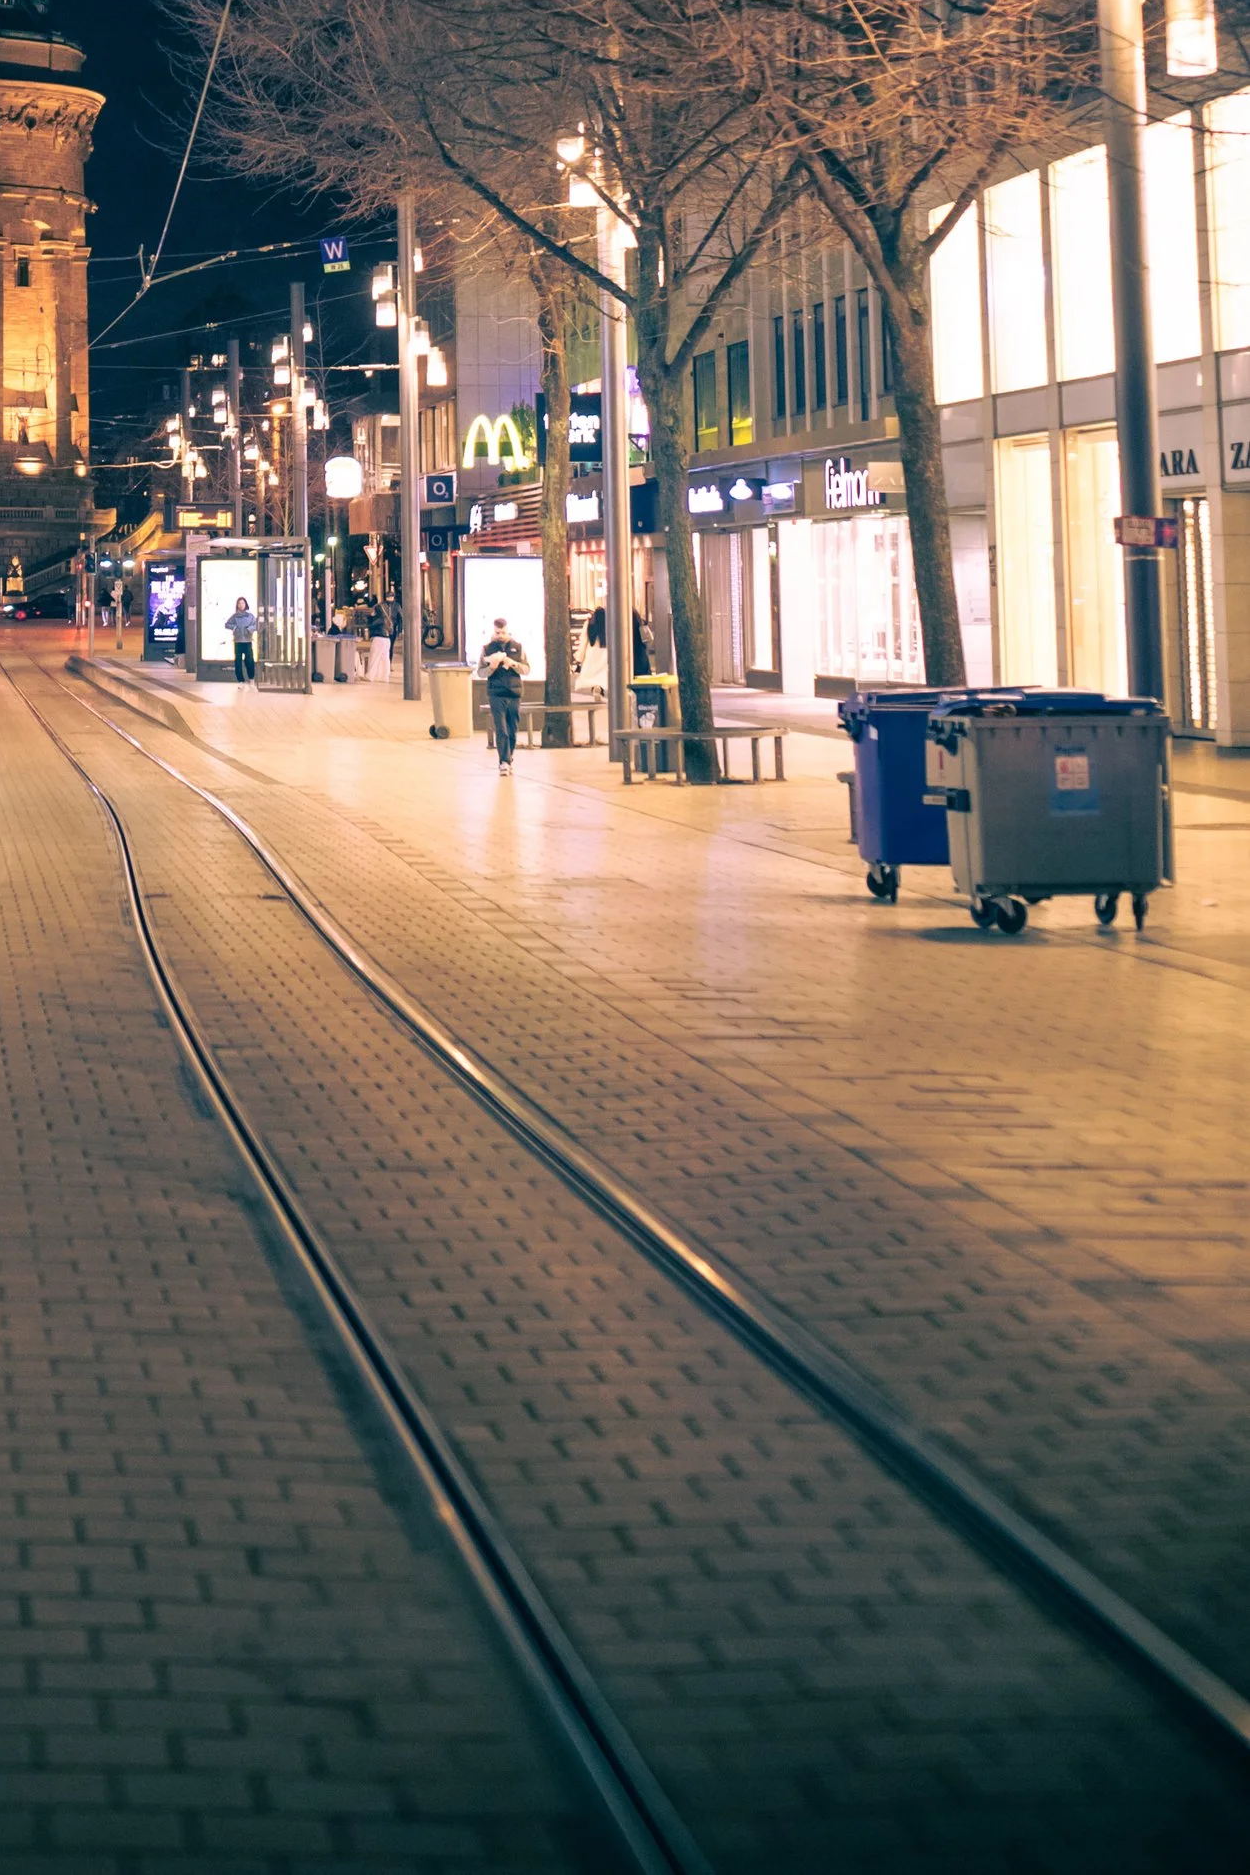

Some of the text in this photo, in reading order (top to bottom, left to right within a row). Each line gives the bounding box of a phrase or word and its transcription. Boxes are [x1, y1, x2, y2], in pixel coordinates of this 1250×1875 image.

[324, 241, 343, 260] W
[1160, 449, 1200, 477] ARA
[1230, 442, 1250, 470] Z
